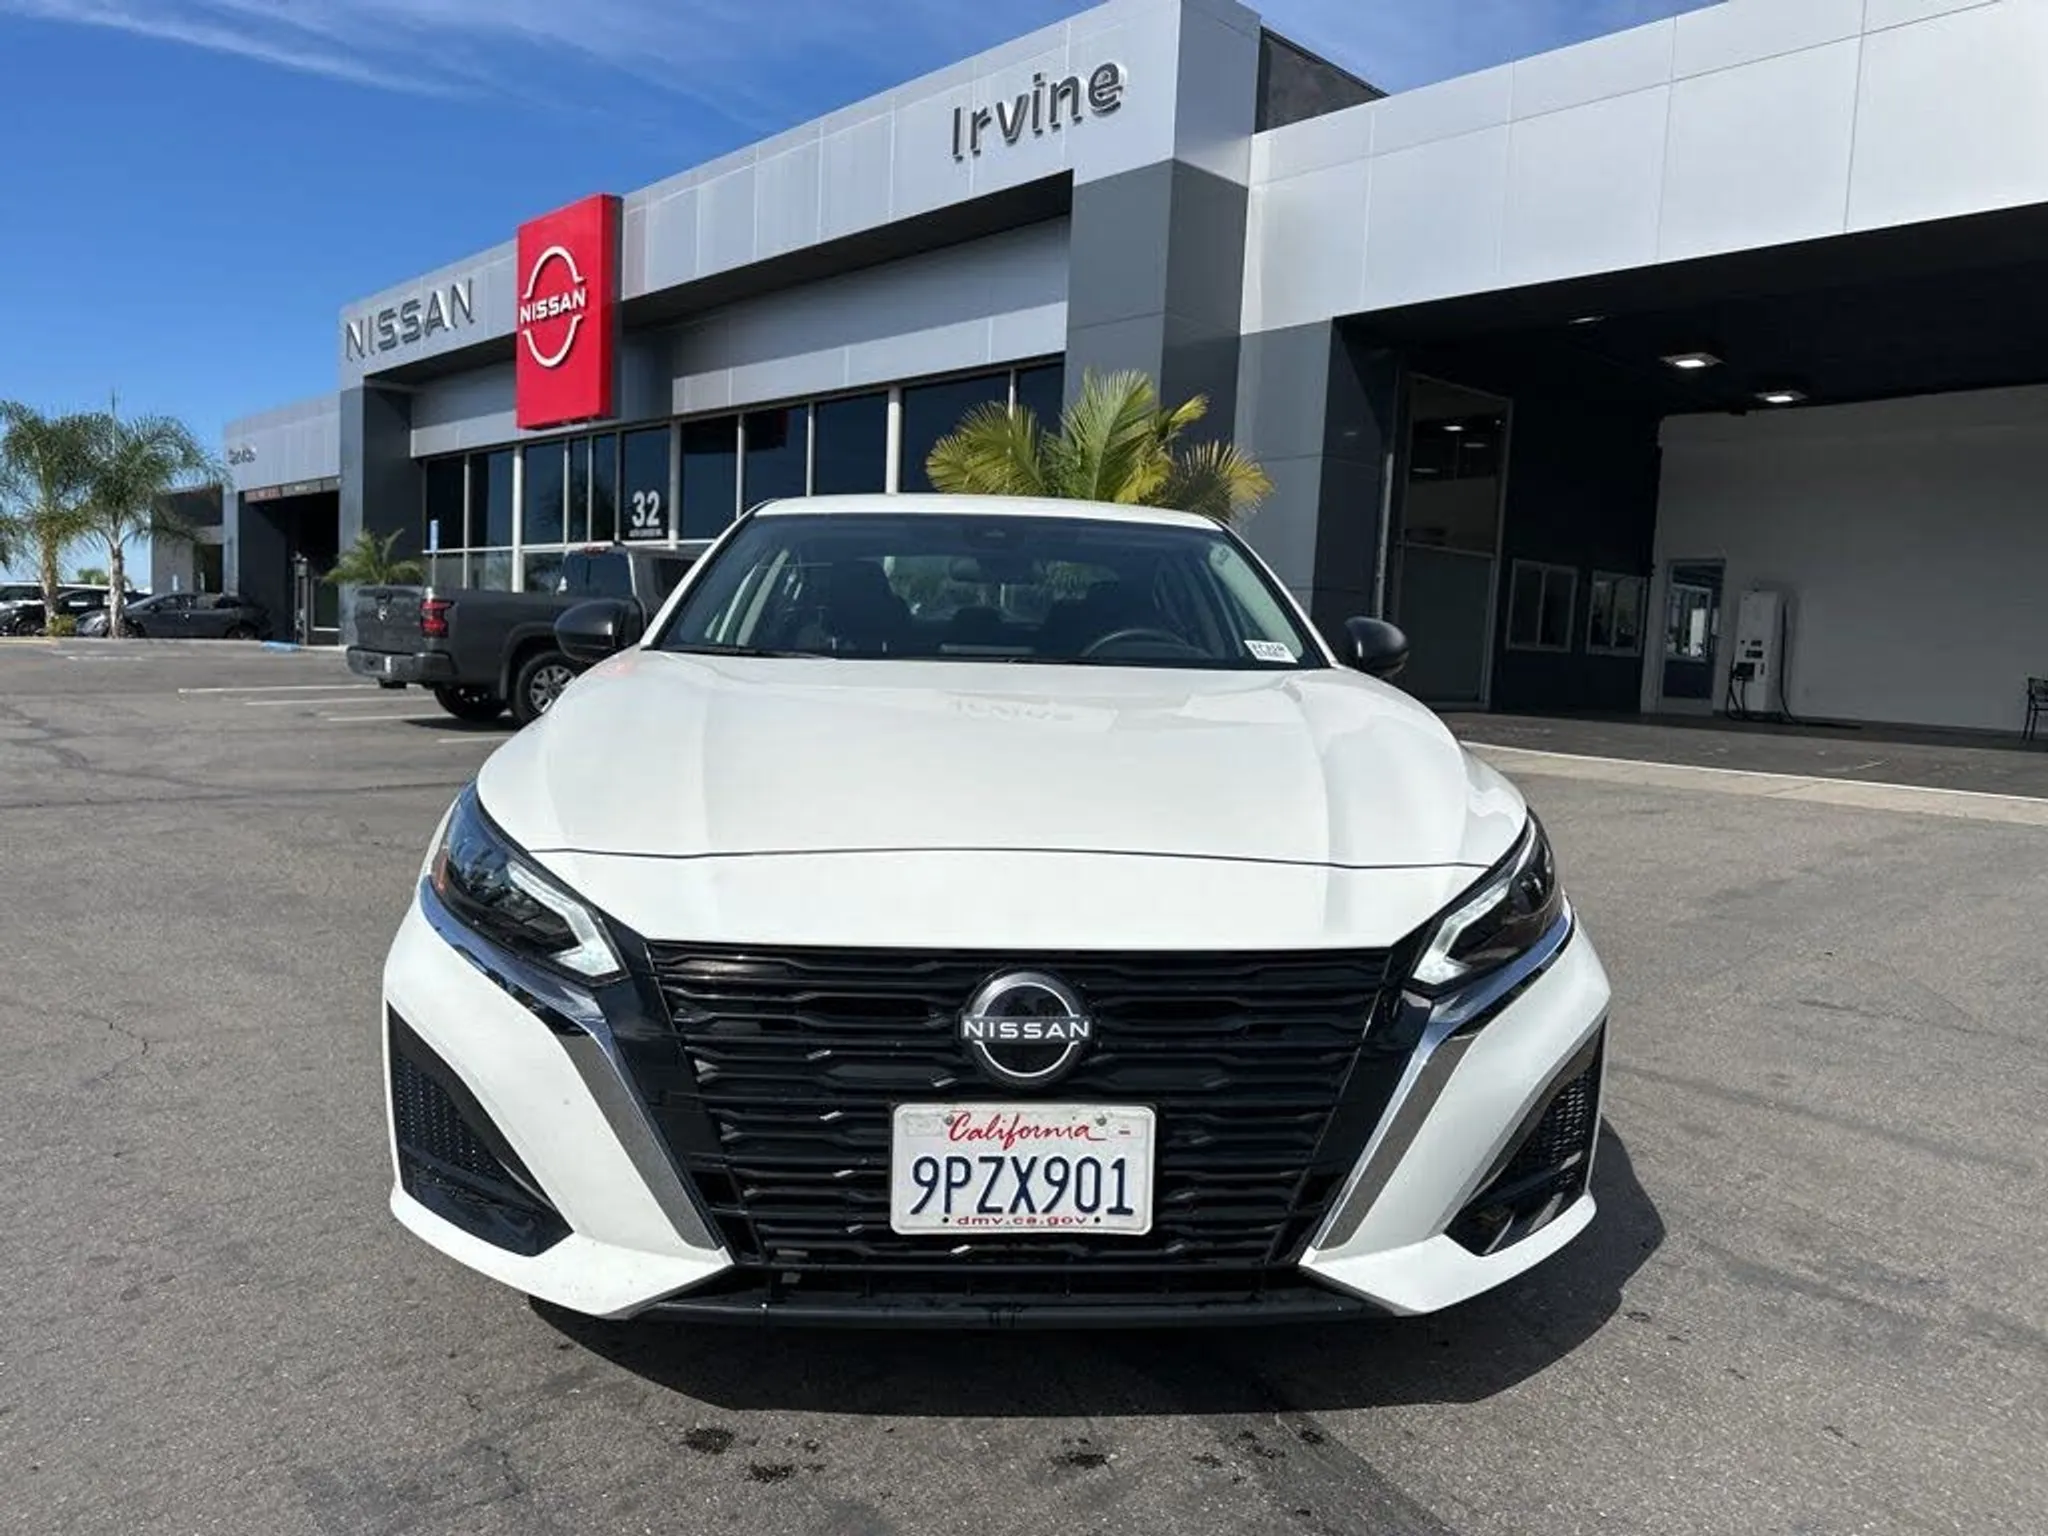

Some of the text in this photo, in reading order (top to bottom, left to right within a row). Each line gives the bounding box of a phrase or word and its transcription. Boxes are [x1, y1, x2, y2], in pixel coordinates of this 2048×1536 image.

[952, 62, 1122, 161] Irvine
[346, 279, 475, 361] NISSAN
[519, 288, 586, 325] NISSAN
[632, 490, 660, 527] 32
[963, 1020, 1090, 1040] NISSAN
[949, 1112, 1106, 1150] California
[910, 1156, 1134, 1215] 9PZX901
[956, 1215, 1088, 1226] dmv.ca.gov
